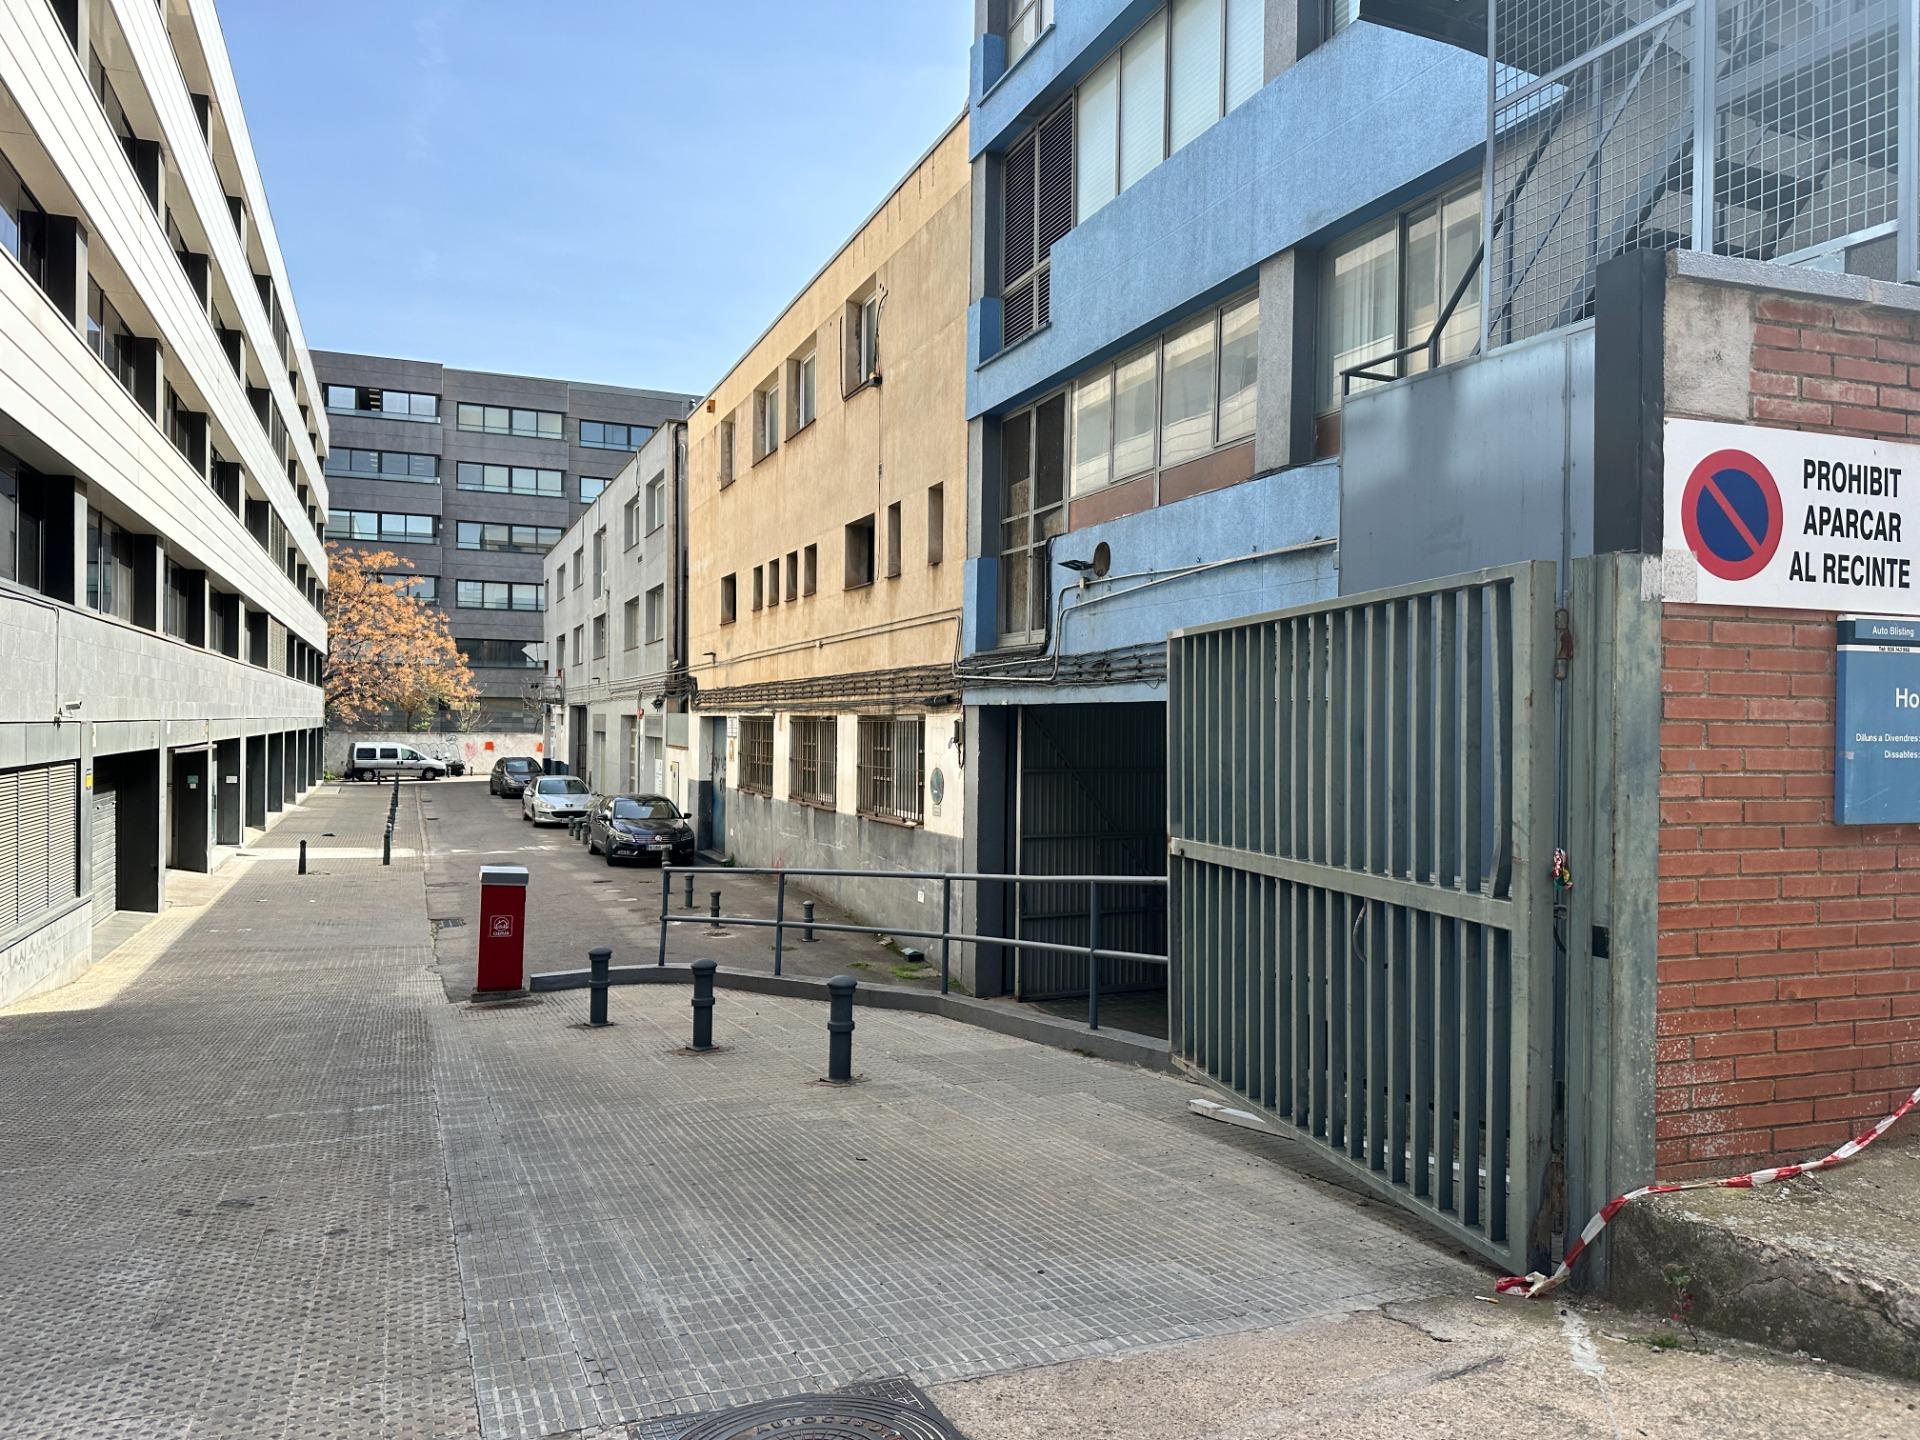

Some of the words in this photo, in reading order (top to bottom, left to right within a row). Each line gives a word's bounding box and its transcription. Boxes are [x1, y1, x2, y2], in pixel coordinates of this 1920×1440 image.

[1803, 458, 1901, 498] PROHIBIT
[1803, 505, 1901, 542] APARCAR
[1789, 551, 1816, 582] AL
[1823, 553, 1910, 588] RECINTE
[1872, 625, 1888, 635] Auto
[1889, 626, 1915, 638] Blisting
[1855, 733, 1878, 742] Dilluns
